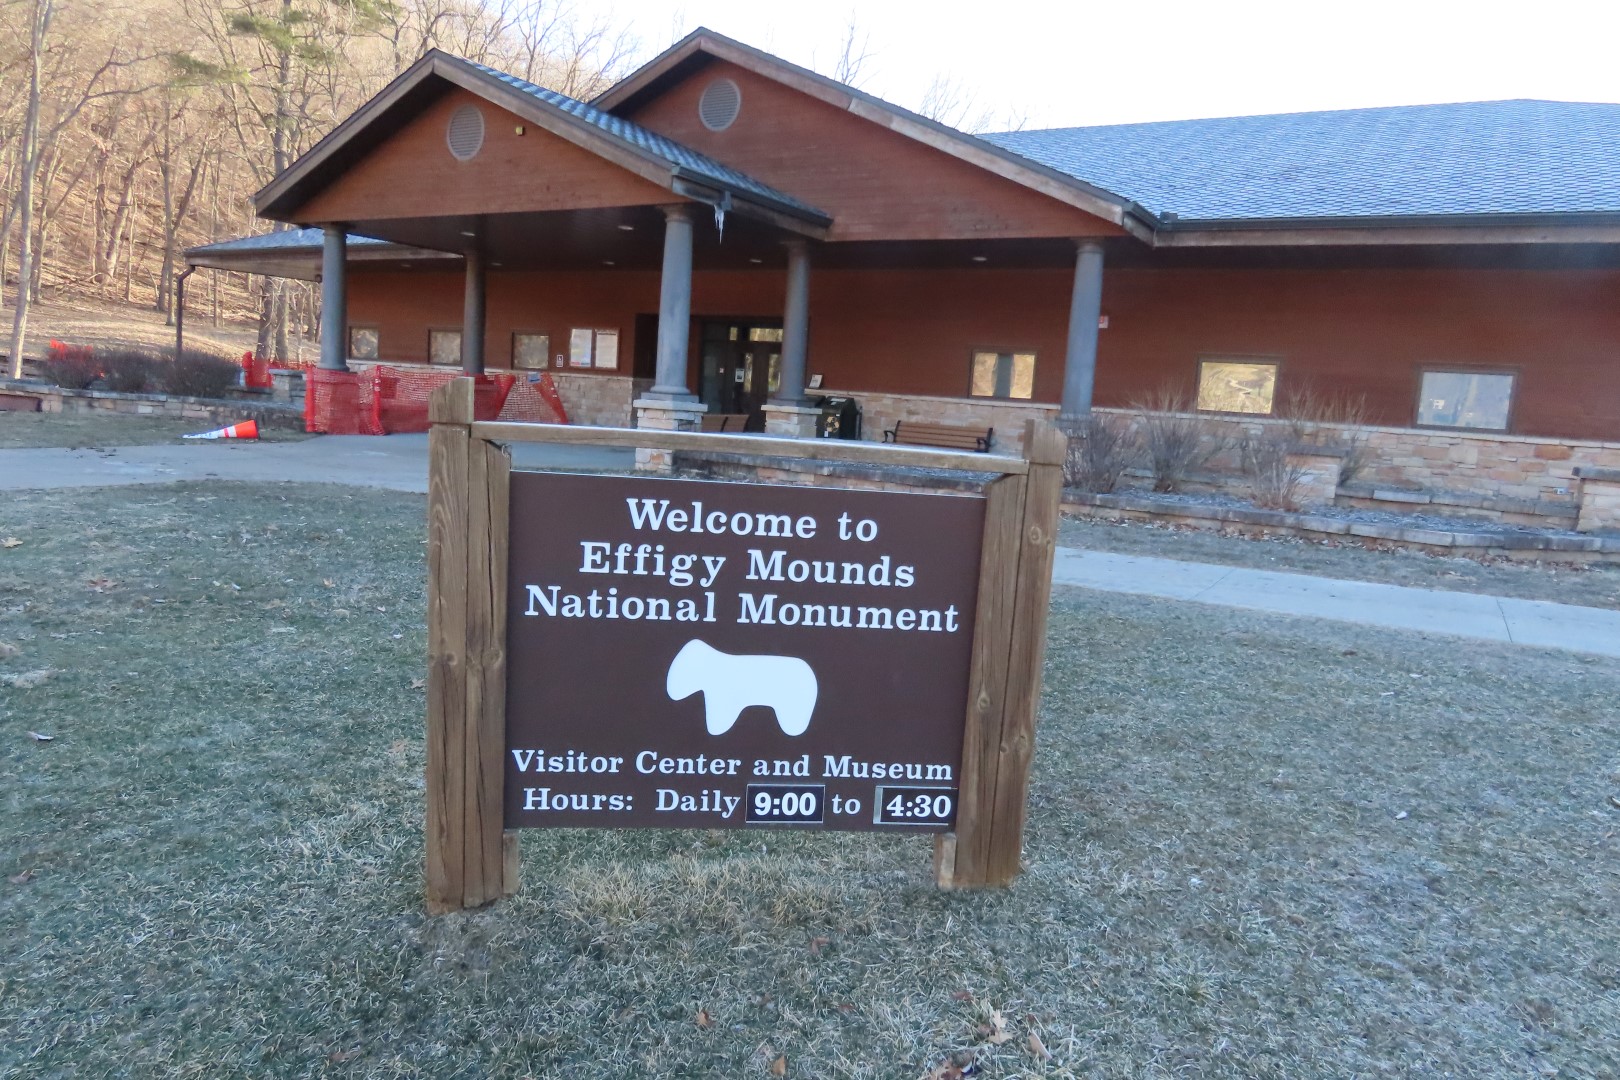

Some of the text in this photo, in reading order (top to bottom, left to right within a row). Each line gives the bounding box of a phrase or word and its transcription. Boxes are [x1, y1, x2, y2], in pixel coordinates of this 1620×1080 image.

[626, 498, 877, 541] Welcome to
[579, 542, 914, 587] Effigy Mounds
[525, 585, 958, 632] National Monument
[512, 750, 952, 780] Visitor Center and Museum
[523, 788, 951, 818] Hours: Daily 9:00 to 4:30
